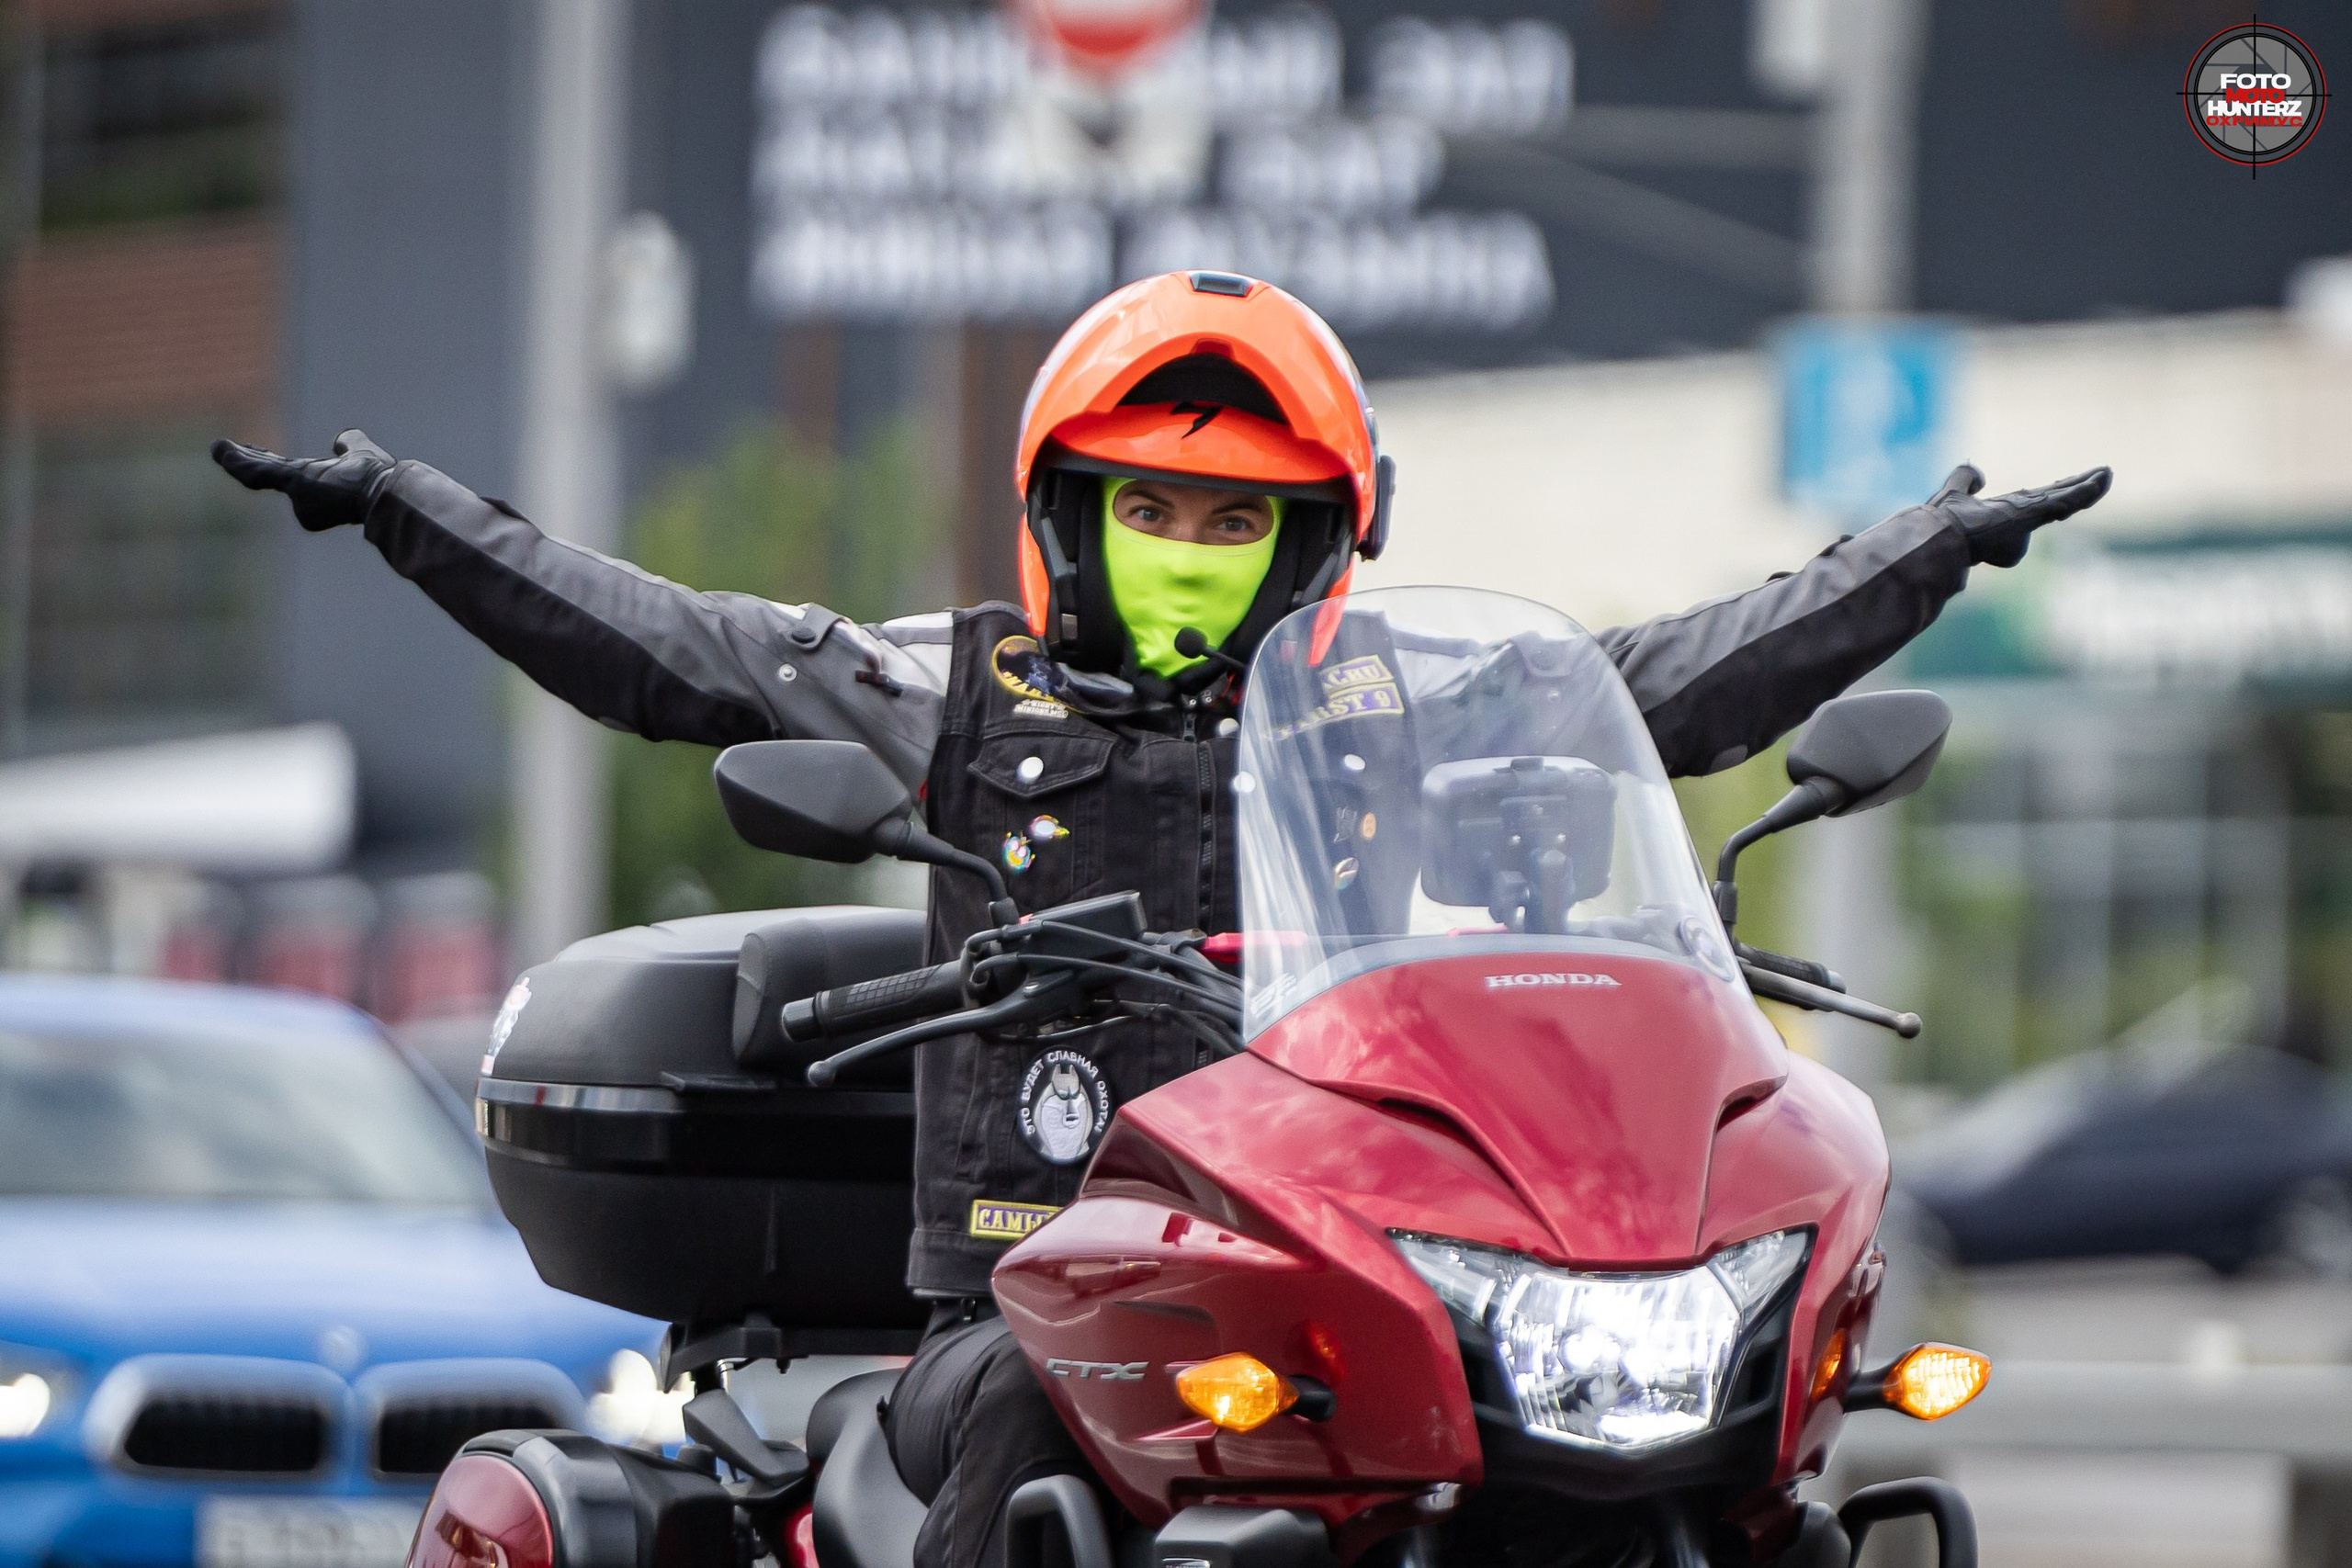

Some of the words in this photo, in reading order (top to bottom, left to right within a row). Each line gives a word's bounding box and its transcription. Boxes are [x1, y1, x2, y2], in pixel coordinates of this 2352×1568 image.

[1484, 973, 1623, 987] HONDA
[1047, 1050, 1100, 1079] СЛАВНАЯ
[1021, 1058, 1045, 1101] БУДЕТ
[1021, 1107, 1036, 1135] ЭТО
[1046, 1357, 1149, 1381] CTX
